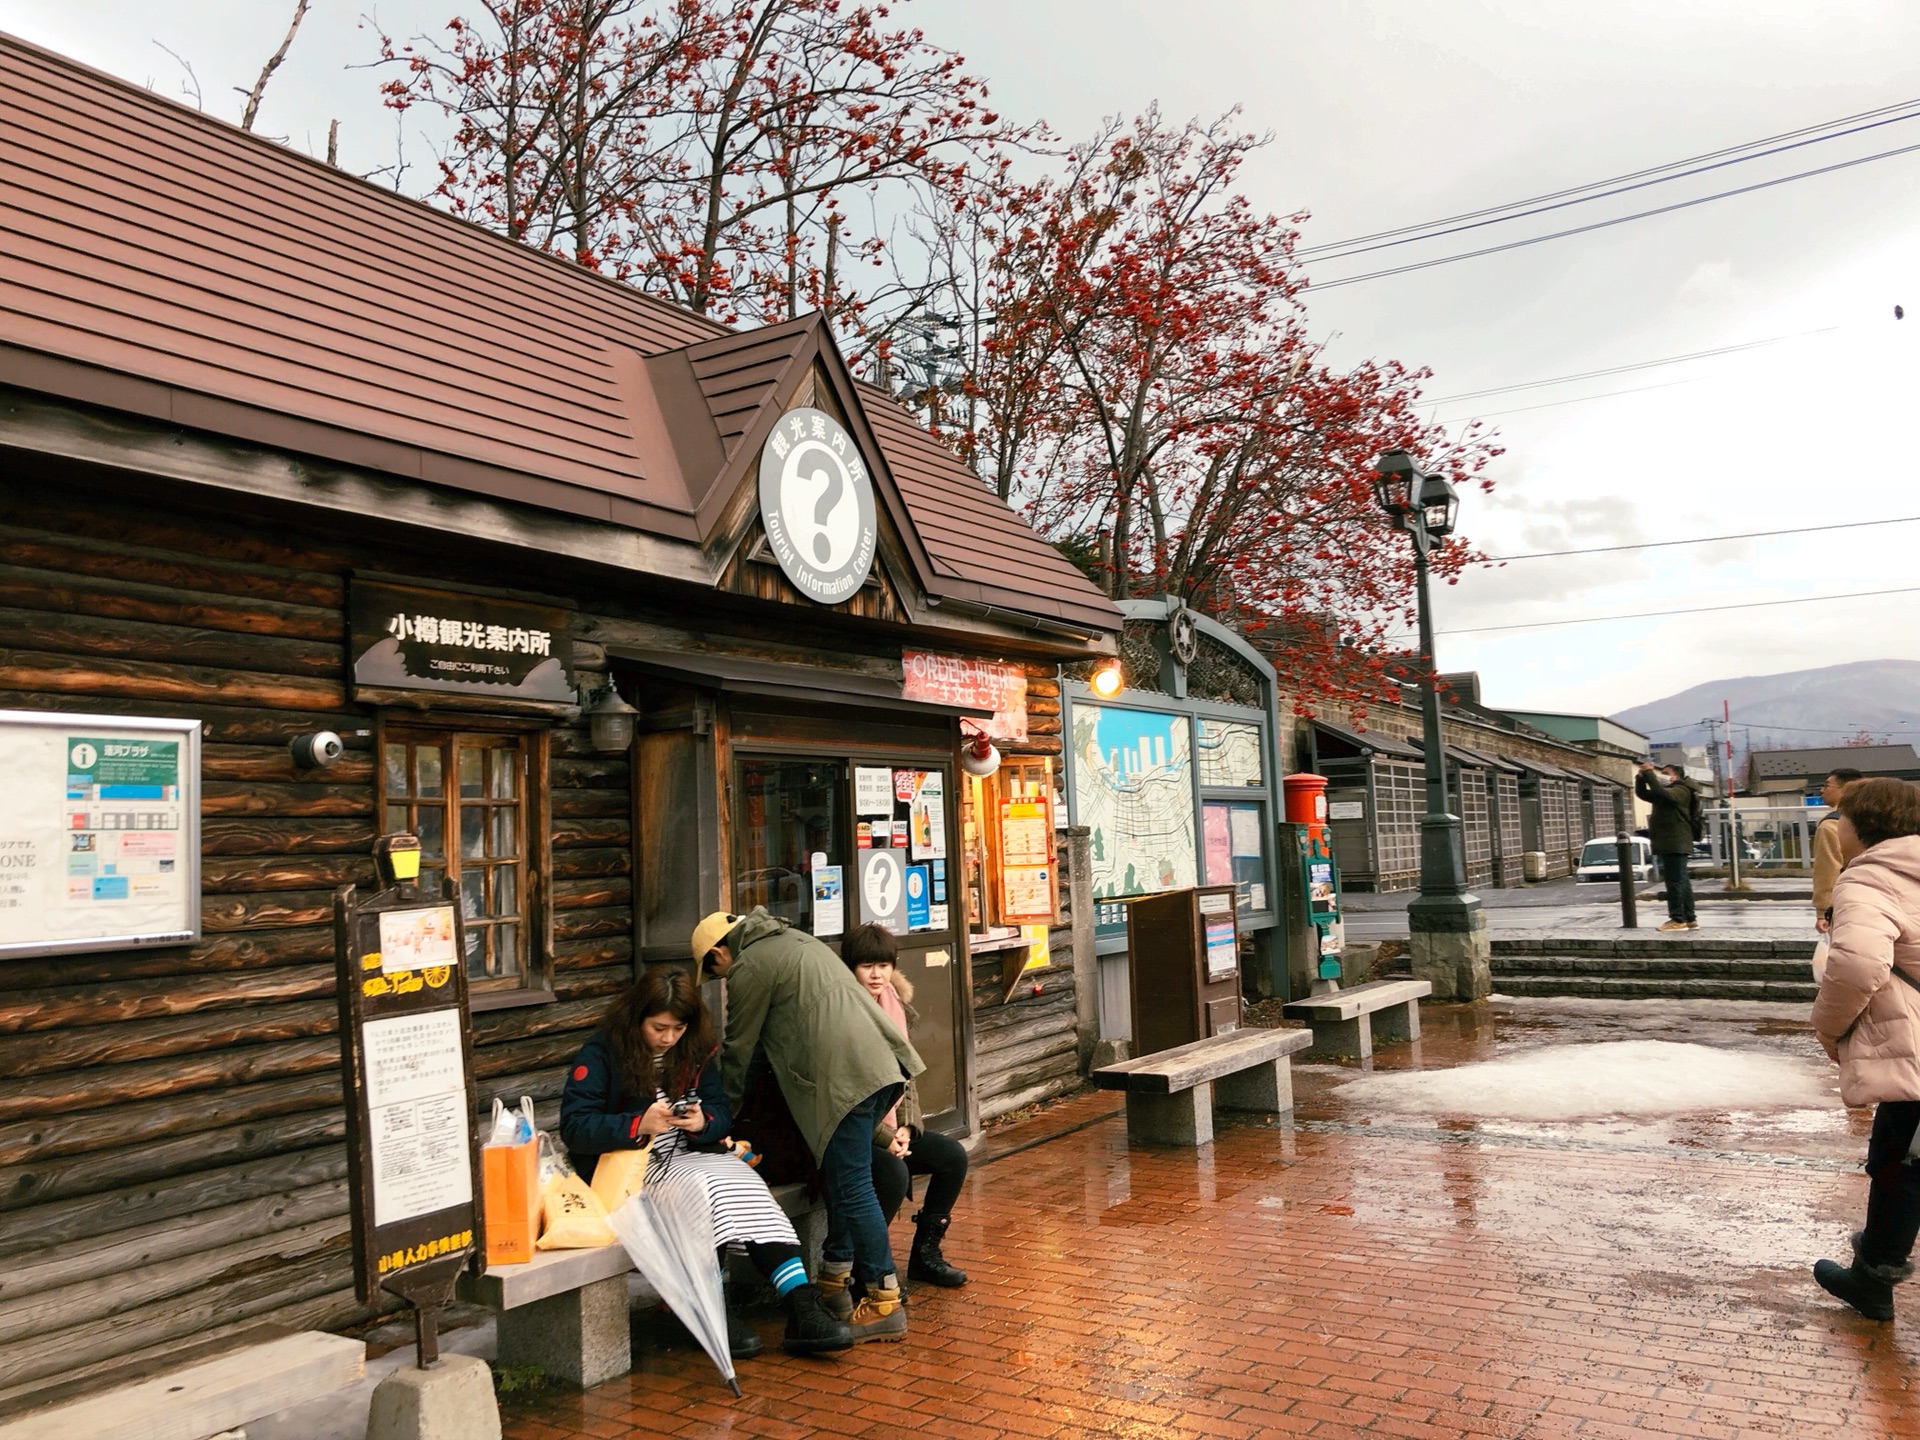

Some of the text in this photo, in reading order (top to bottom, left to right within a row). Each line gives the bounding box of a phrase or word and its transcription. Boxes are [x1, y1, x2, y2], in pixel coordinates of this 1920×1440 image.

[771, 415, 864, 482] 観光案内所
[767, 509, 873, 596] Tourist Information Center
[388, 612, 551, 657] 小樽観光案内所
[429, 658, 510, 676] ご自由にご利用下さい
[912, 653, 1019, 691] ORDER HERE
[926, 682, 1008, 710] ご注文はこちら
[104, 744, 149, 758] 運河プラザ
